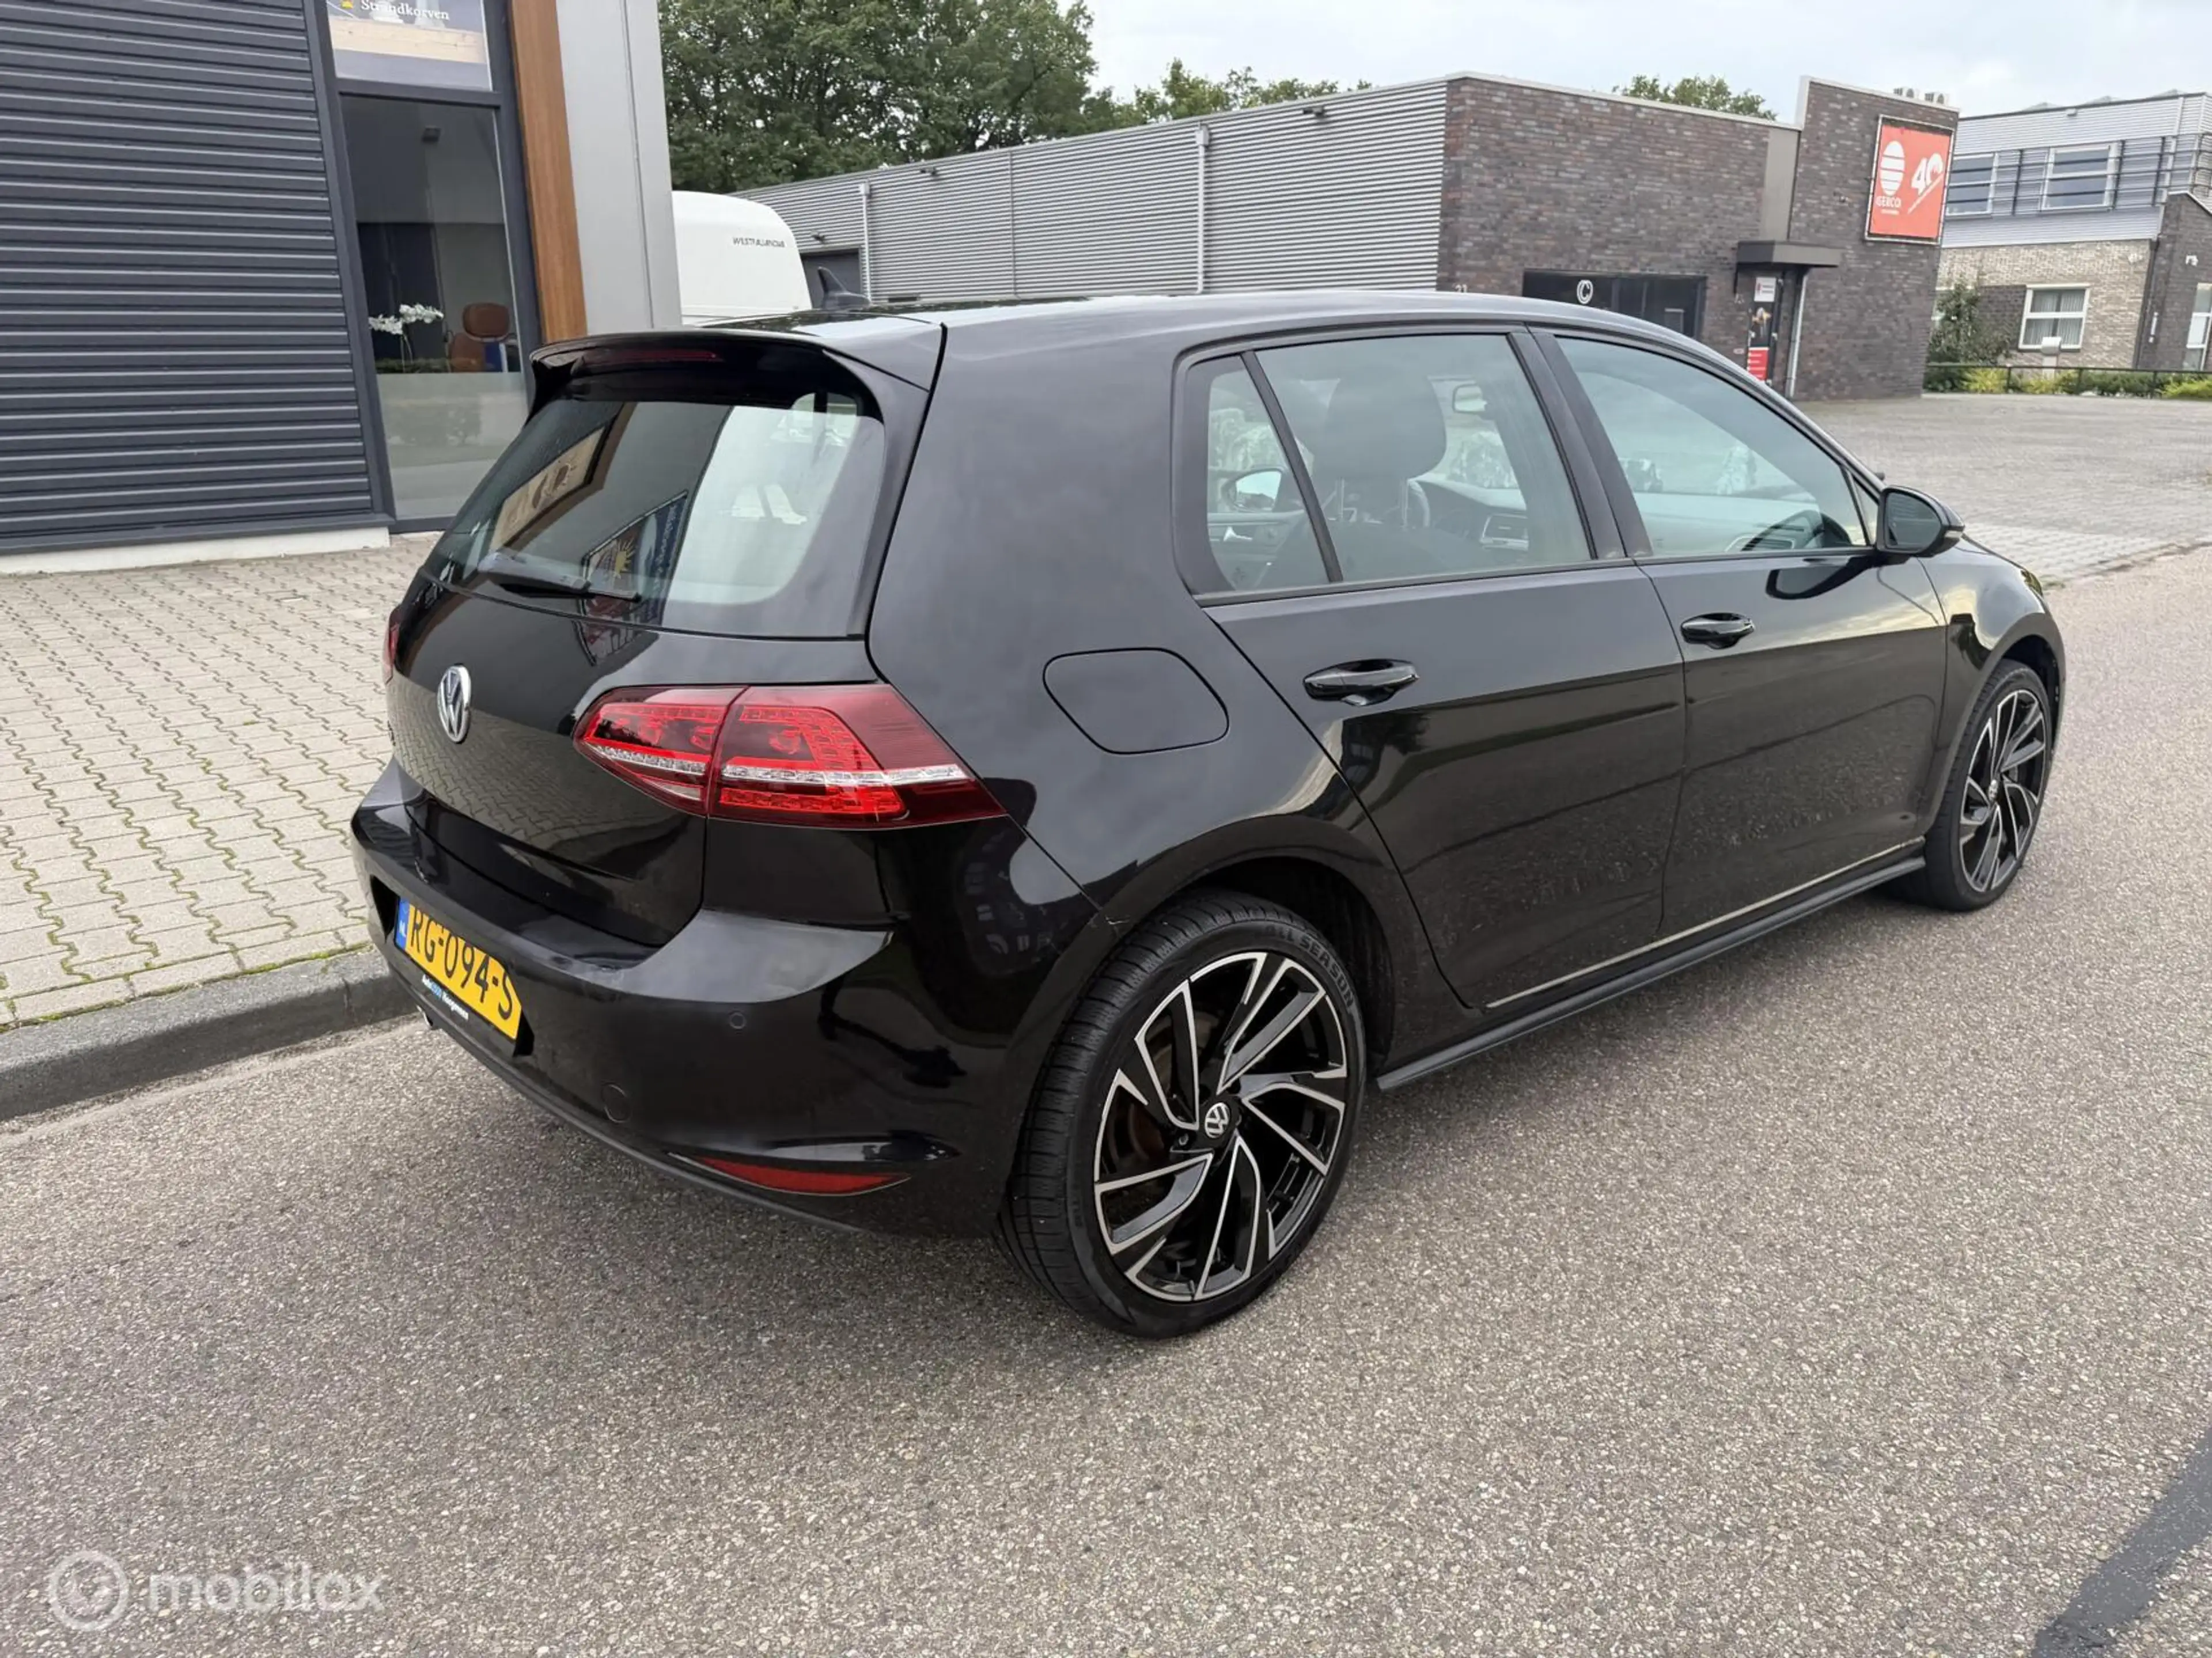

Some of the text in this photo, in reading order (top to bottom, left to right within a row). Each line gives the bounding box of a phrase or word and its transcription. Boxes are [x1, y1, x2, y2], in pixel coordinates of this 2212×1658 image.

[361, 0, 450, 20] Strndkorven
[411, 907, 513, 1020] RG-094-S
[1299, 934, 1354, 1008] SEASON
